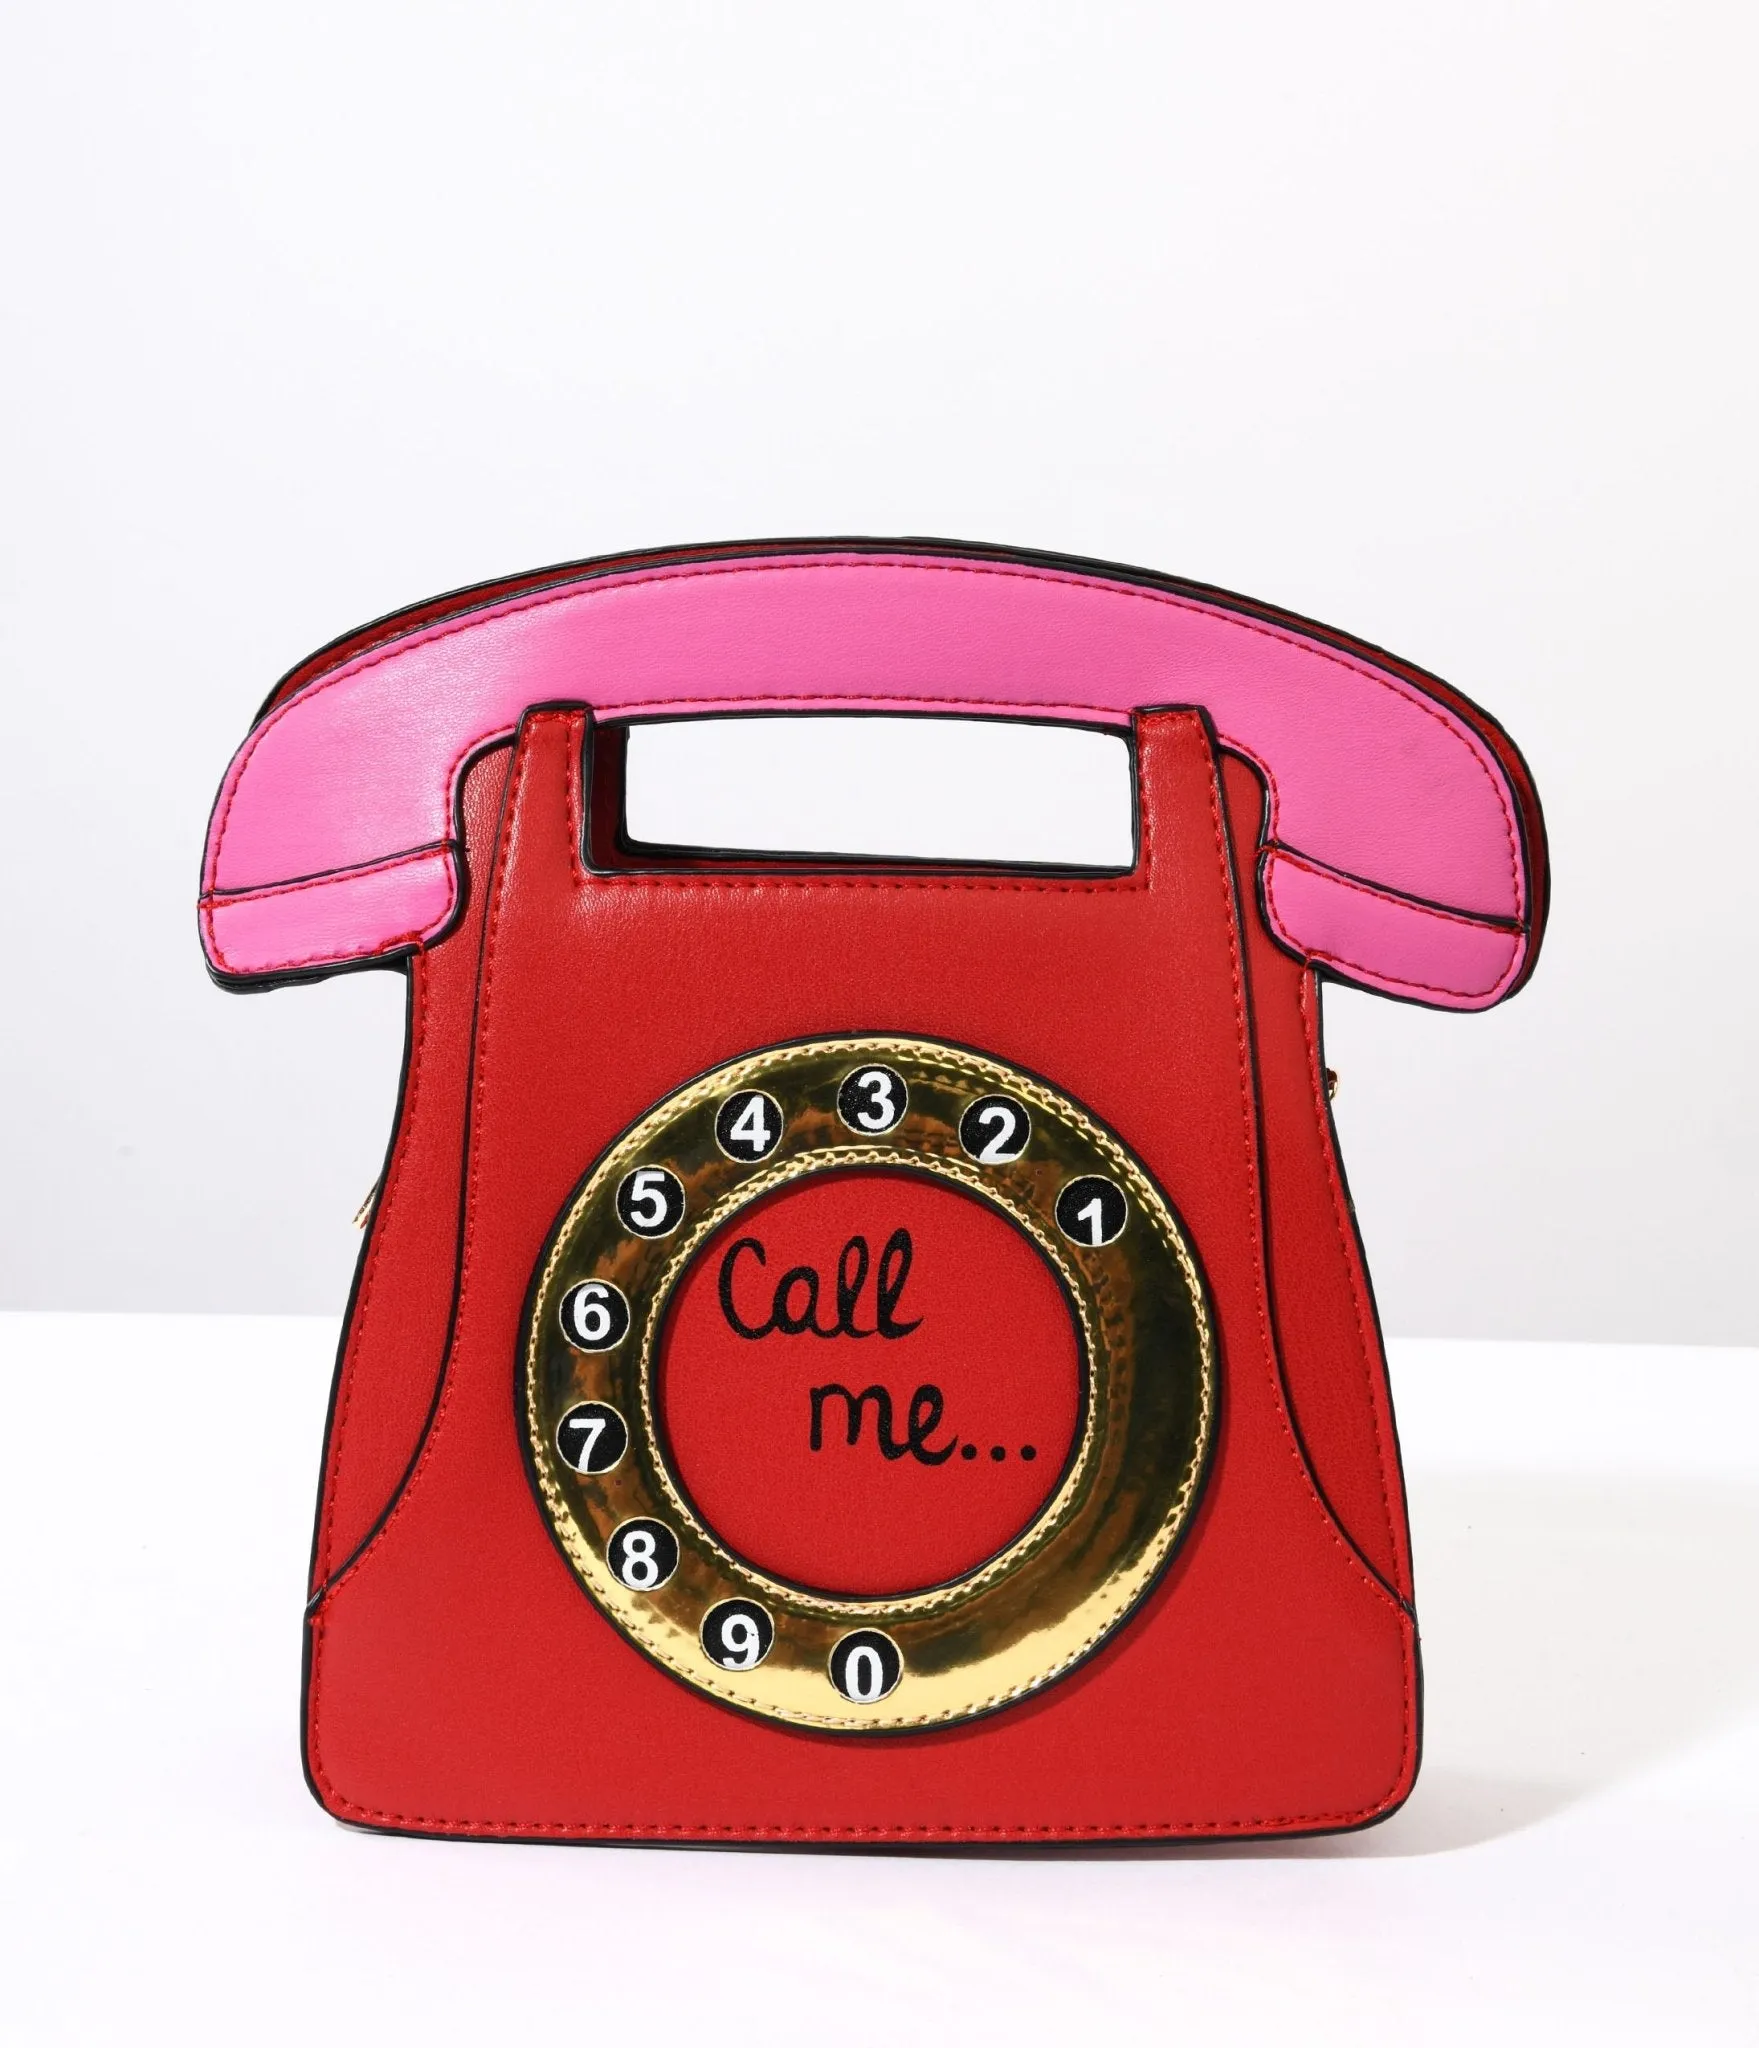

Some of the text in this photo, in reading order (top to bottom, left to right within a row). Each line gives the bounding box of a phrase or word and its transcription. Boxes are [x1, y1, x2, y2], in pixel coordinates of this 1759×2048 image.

[730, 1094, 771, 1152] 4
[856, 1071, 895, 1129] 3
[979, 1106, 1018, 1161] 2
[630, 1171, 668, 1228] 5
[1077, 1198, 1103, 1245] 1
[573, 1284, 611, 1341] 6
[718, 1229, 922, 1340] Call
[569, 1418, 606, 1470] 7
[809, 1383, 1037, 1466] me...
[621, 1530, 659, 1588] 8
[720, 1613, 760, 1668] 9
[845, 1645, 884, 1698] 0
